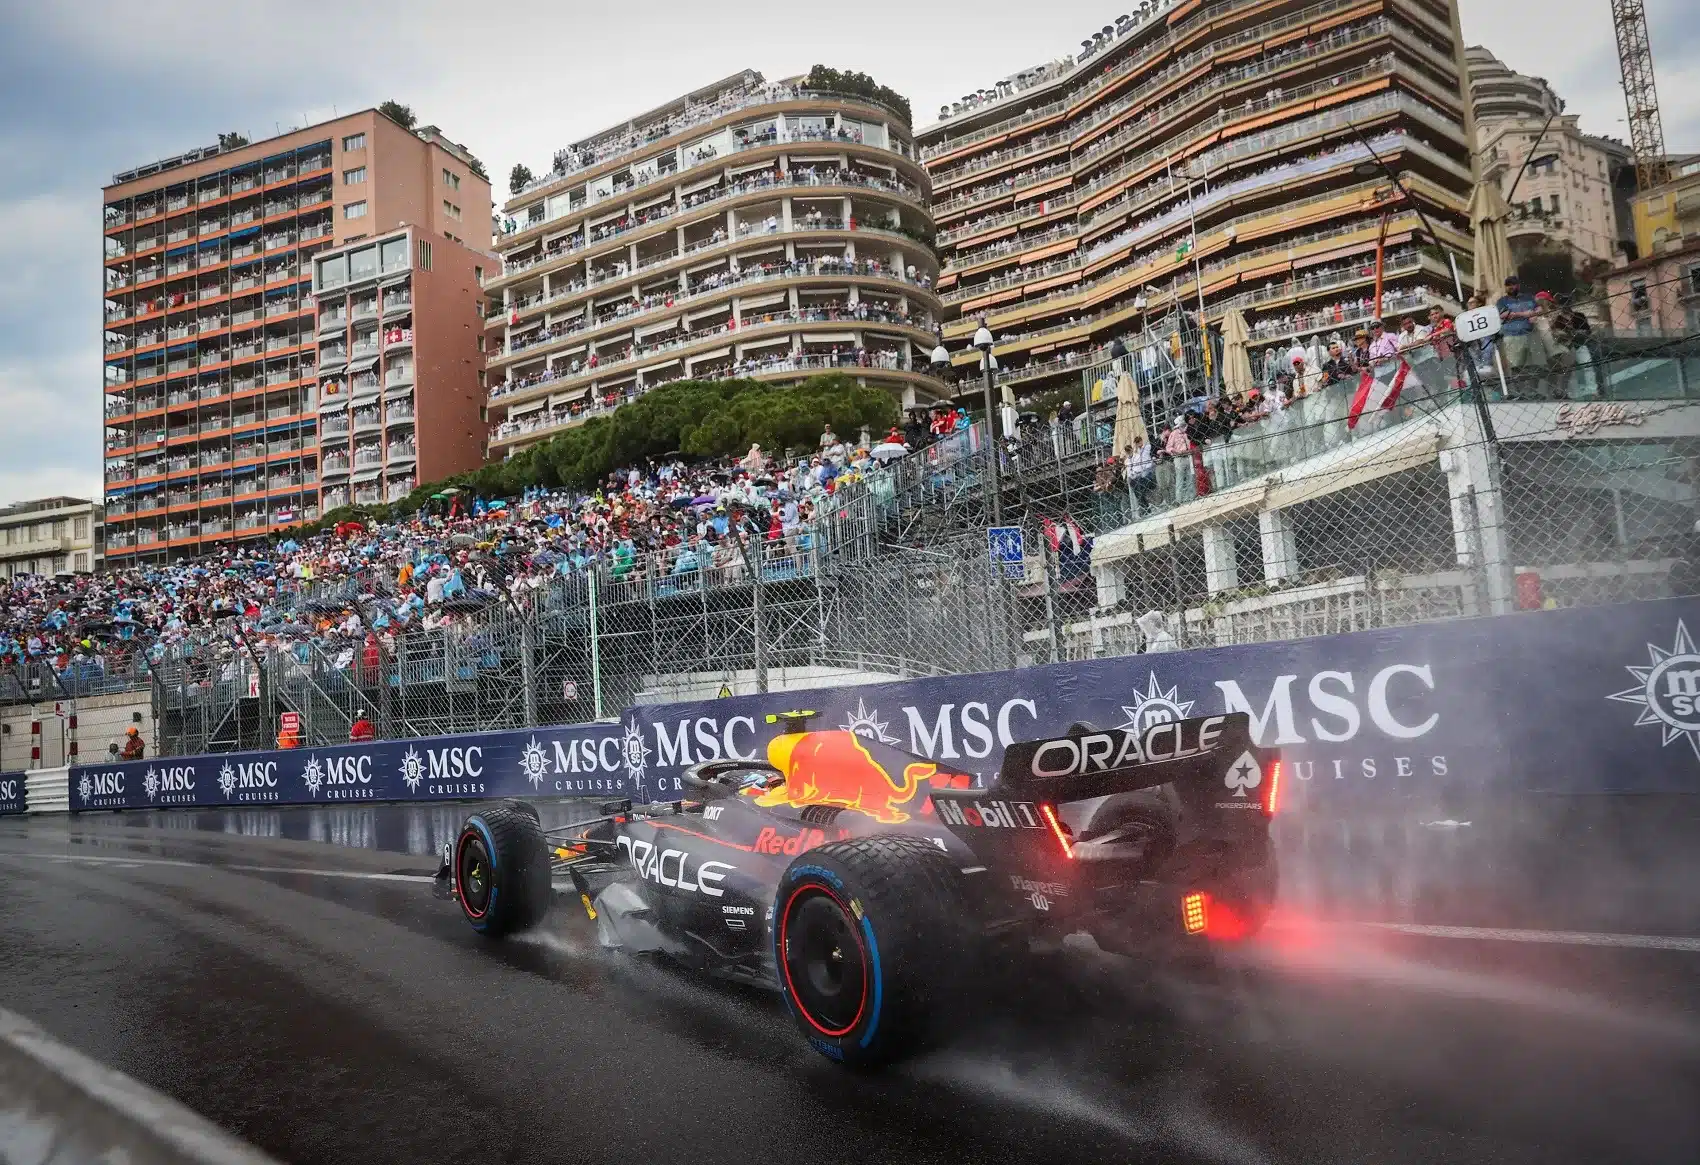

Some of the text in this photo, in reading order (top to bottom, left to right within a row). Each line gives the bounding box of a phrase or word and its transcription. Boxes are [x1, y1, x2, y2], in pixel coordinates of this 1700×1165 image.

[1467, 316, 1489, 333] 18
[1214, 664, 1440, 747] MSC
[902, 698, 1038, 759] MSC
[652, 715, 757, 767] MSC
[1031, 716, 1226, 777] ORACLE
[427, 746, 483, 779] MSC
[552, 737, 621, 774] MSC
[160, 766, 196, 791] MSC
[237, 761, 278, 789] MSC
[325, 755, 373, 785] MSC
[1292, 755, 1449, 781] UISES
[0, 779, 17, 801] SC
[93, 771, 126, 795] MSC
[327, 788, 374, 799] CRUISES
[429, 783, 485, 795] CRUISES
[554, 779, 623, 791] CRUISES
[93, 797, 126, 806] CRUISES
[160, 793, 196, 802] CRUISES
[239, 791, 279, 801] CRUISES
[1214, 802, 1263, 810] POKERSTARS
[702, 806, 725, 821] ROKT
[935, 799, 1037, 828] Mobil 1
[755, 827, 807, 856] Red
[722, 905, 755, 915] SIEMENS
